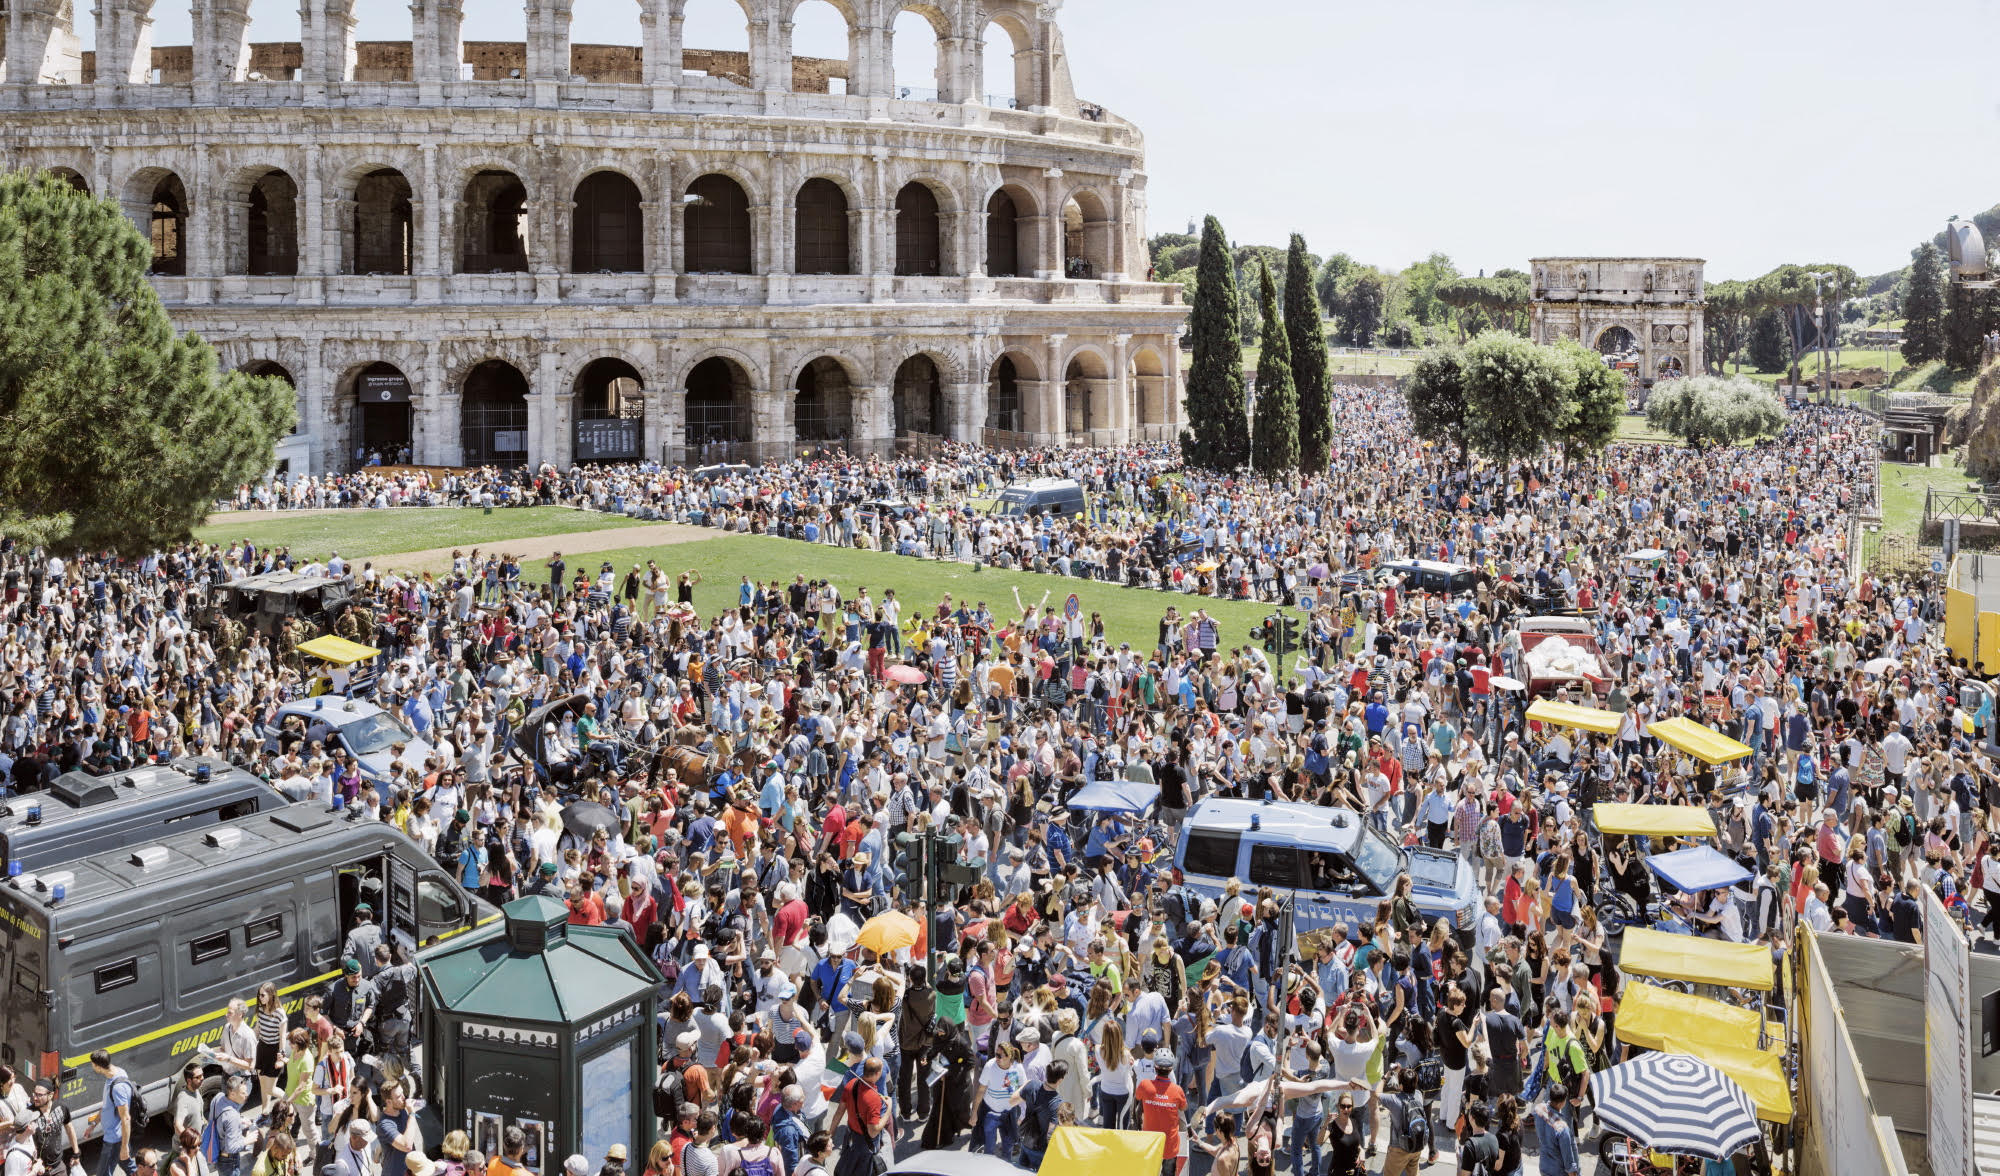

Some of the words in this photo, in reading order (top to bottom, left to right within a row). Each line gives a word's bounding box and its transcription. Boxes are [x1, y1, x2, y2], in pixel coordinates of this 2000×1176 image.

[16, 918, 40, 940] FINANZA
[171, 1025, 223, 1057] GUARDI
[66, 1078, 83, 1091] 117
